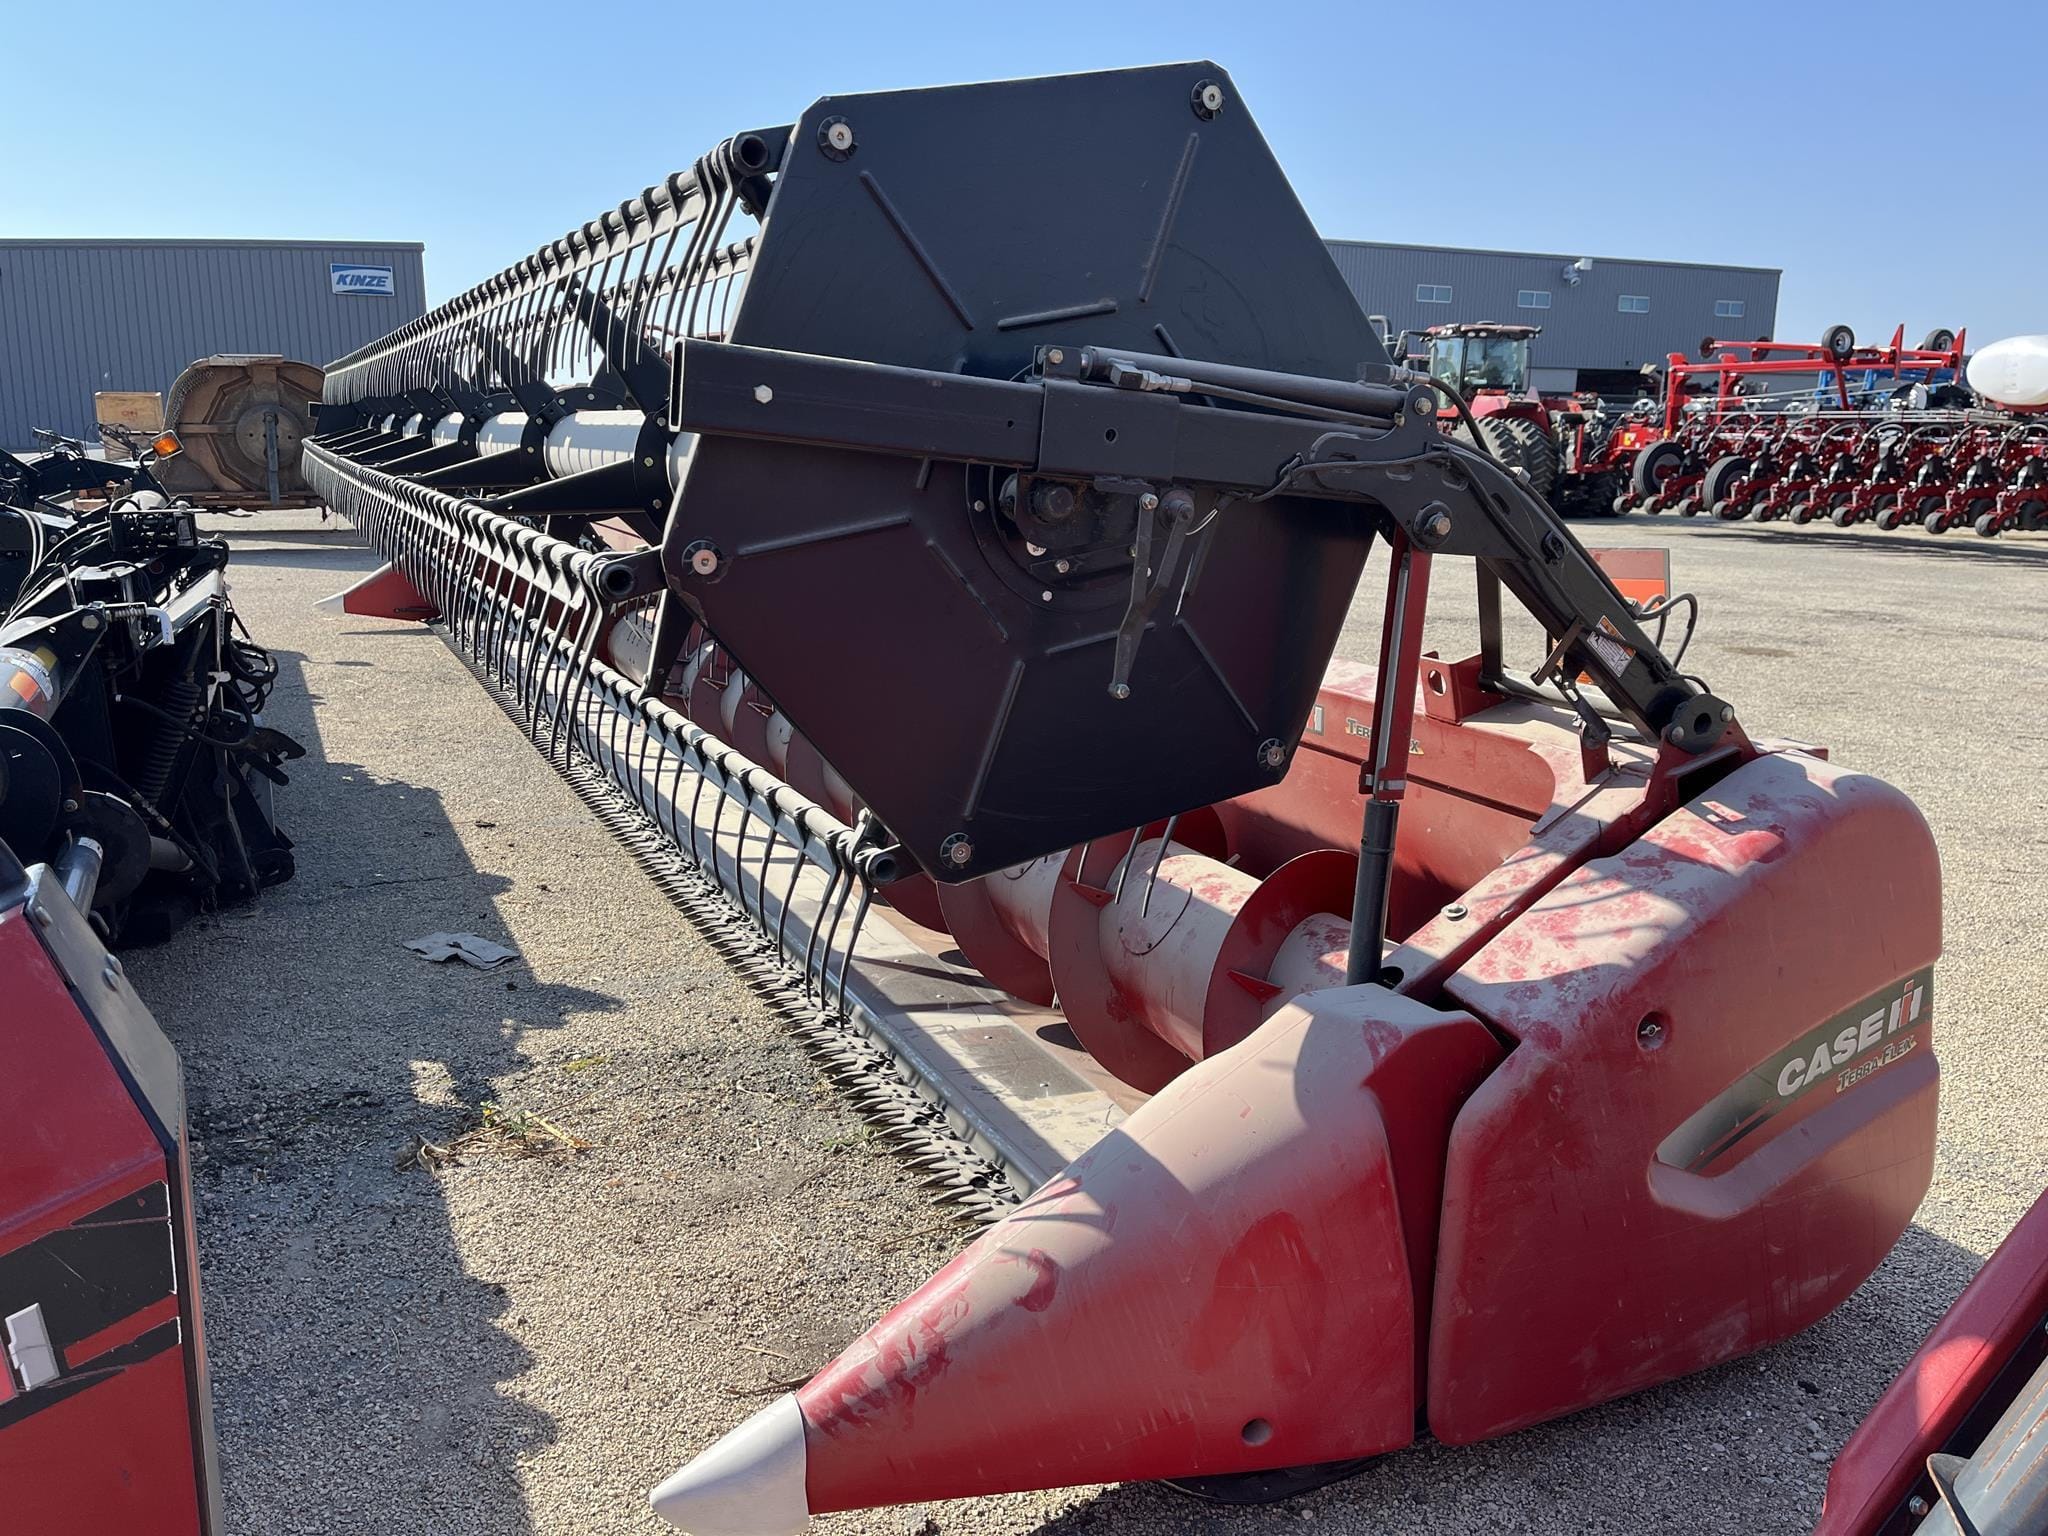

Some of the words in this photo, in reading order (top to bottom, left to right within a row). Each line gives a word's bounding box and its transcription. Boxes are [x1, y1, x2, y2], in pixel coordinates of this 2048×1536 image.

[336, 274, 389, 287] KINZE
[1346, 718, 1371, 738] TER
[1777, 1008, 1885, 1096] CASE
